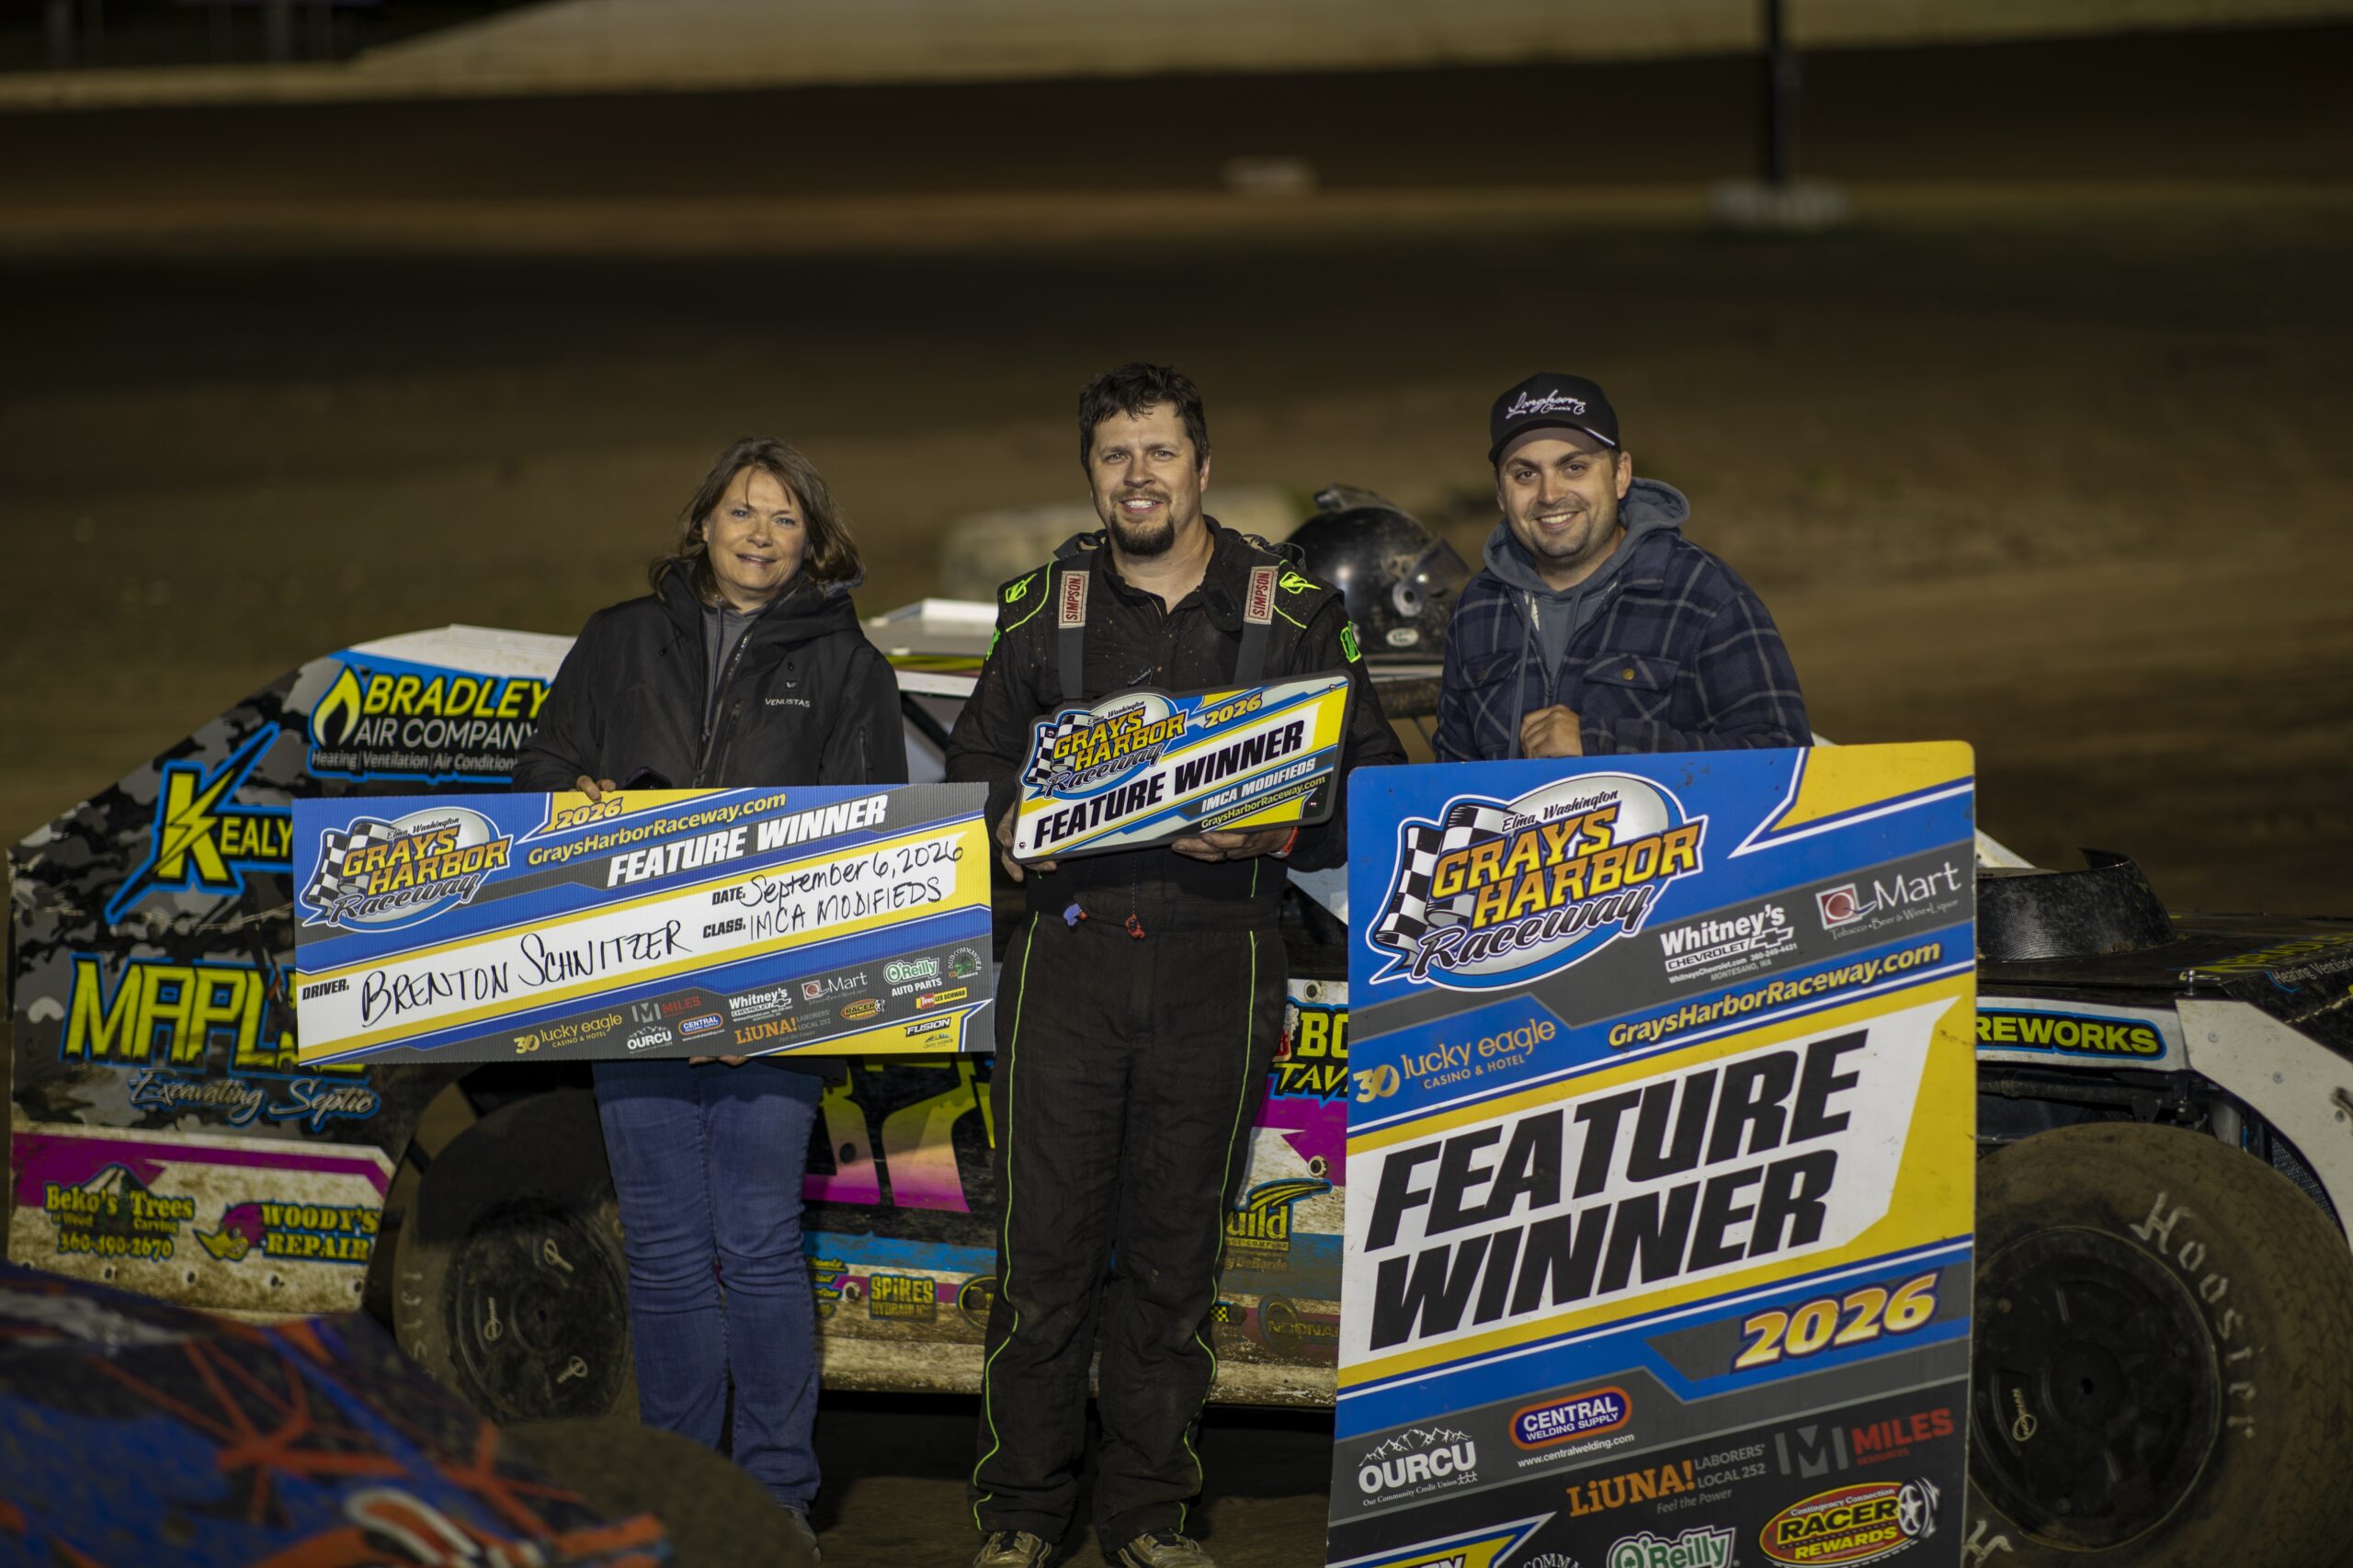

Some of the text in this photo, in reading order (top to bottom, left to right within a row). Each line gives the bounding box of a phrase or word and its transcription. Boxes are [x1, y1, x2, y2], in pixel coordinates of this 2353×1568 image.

[1065, 577, 1082, 620] SIMPSON
[1252, 572, 1270, 616] SIMPSON
[363, 674, 551, 720] BRADLEY
[765, 698, 811, 708] VENUSTAS
[1087, 700, 1145, 725] Elma Washington
[1204, 693, 1263, 729] 2026
[353, 717, 398, 747] AIR
[1053, 707, 1144, 760] GRAYS
[1073, 713, 1186, 773] HARBOR
[312, 749, 518, 772] Heating Ventilation Air Condition
[1045, 744, 1165, 797] Raceway
[1033, 720, 1304, 849] FEATURE WINNER
[1200, 776, 1325, 828] GraysHarborRaceway.com
[1201, 757, 1316, 813] IMCA MODIFIEDS
[153, 767, 293, 881] KEALY
[386, 816, 460, 841] Elma Washington
[529, 792, 787, 866] GraysHarborRaceway.com
[555, 797, 624, 830] 2026
[1501, 790, 1619, 833] Elma Washington
[342, 827, 460, 877] GRAYS
[607, 794, 888, 888] FEATURE WINNER
[1432, 806, 1618, 899] GRAYS
[368, 840, 510, 896] HARBOR
[738, 862, 870, 908] September
[1472, 824, 1699, 930] HARBOR
[1872, 861, 1962, 911] Mart
[329, 874, 479, 924] Raceway
[750, 876, 942, 940] IMCA MODIFIEDS
[1412, 885, 1654, 978] Raceway
[1660, 903, 1786, 957] Whitney's
[361, 919, 693, 1028] BRENTON SCHNITZER
[886, 960, 938, 983] O'Reilly
[1668, 941, 1746, 971] CHEVROLET
[1668, 957, 1748, 984] WhitneysChevrolet.com
[1710, 958, 1773, 982] MONTESANO, WA
[728, 987, 789, 1010] Whitney's
[828, 971, 869, 994] Mart
[892, 977, 943, 997] AUTO PARTS
[1608, 941, 1941, 1048] GraysHarborRaceway.com
[662, 995, 702, 1015] MILES
[683, 1016, 719, 1029] CENTRAL
[846, 1003, 876, 1015] RACER
[540, 1021, 579, 1044] lucky
[581, 1013, 623, 1034] eagle
[551, 1035, 578, 1049] CASINO
[587, 1030, 608, 1042] HOTEL
[627, 1030, 672, 1050] OURCU
[734, 1017, 798, 1045] LiUNA!
[906, 1017, 951, 1036] FUSION
[1976, 1016, 2158, 1054] REWORKS
[1353, 1018, 1555, 1103] 30 lucky eagle
[1423, 1053, 1526, 1090] CASINO & HOTEL
[269, 1077, 376, 1126] Septic
[1364, 1028, 1870, 1253] FEATURE
[130, 1190, 194, 1219] Trees
[261, 1204, 380, 1234] WOODY'S
[1226, 1204, 1289, 1240] uild
[265, 1233, 369, 1262] REPAIR
[1369, 1148, 1838, 1351] WINNER
[1734, 1274, 1938, 1369] 2026
[1522, 1395, 1619, 1433] CENTRAL
[1526, 1411, 1619, 1442] WELDING SUPPLY
[1850, 1406, 1955, 1456] MILES
[1358, 1440, 1477, 1494] OURCU
[1517, 1432, 1634, 1469] www.centralwelding.com
[1694, 1443, 1766, 1471] LABORERS'
[1362, 1478, 1458, 1507] Our Community Credit Union
[1566, 1459, 1697, 1517] LiUNA!
[1698, 1463, 1767, 1488] LOCAL 252
[1656, 1487, 1733, 1515] Feel the Power
[1779, 1498, 1899, 1542] RACER
[1790, 1487, 1896, 1517] Contingency Connection
[1794, 1525, 1898, 1560] REWARDS
